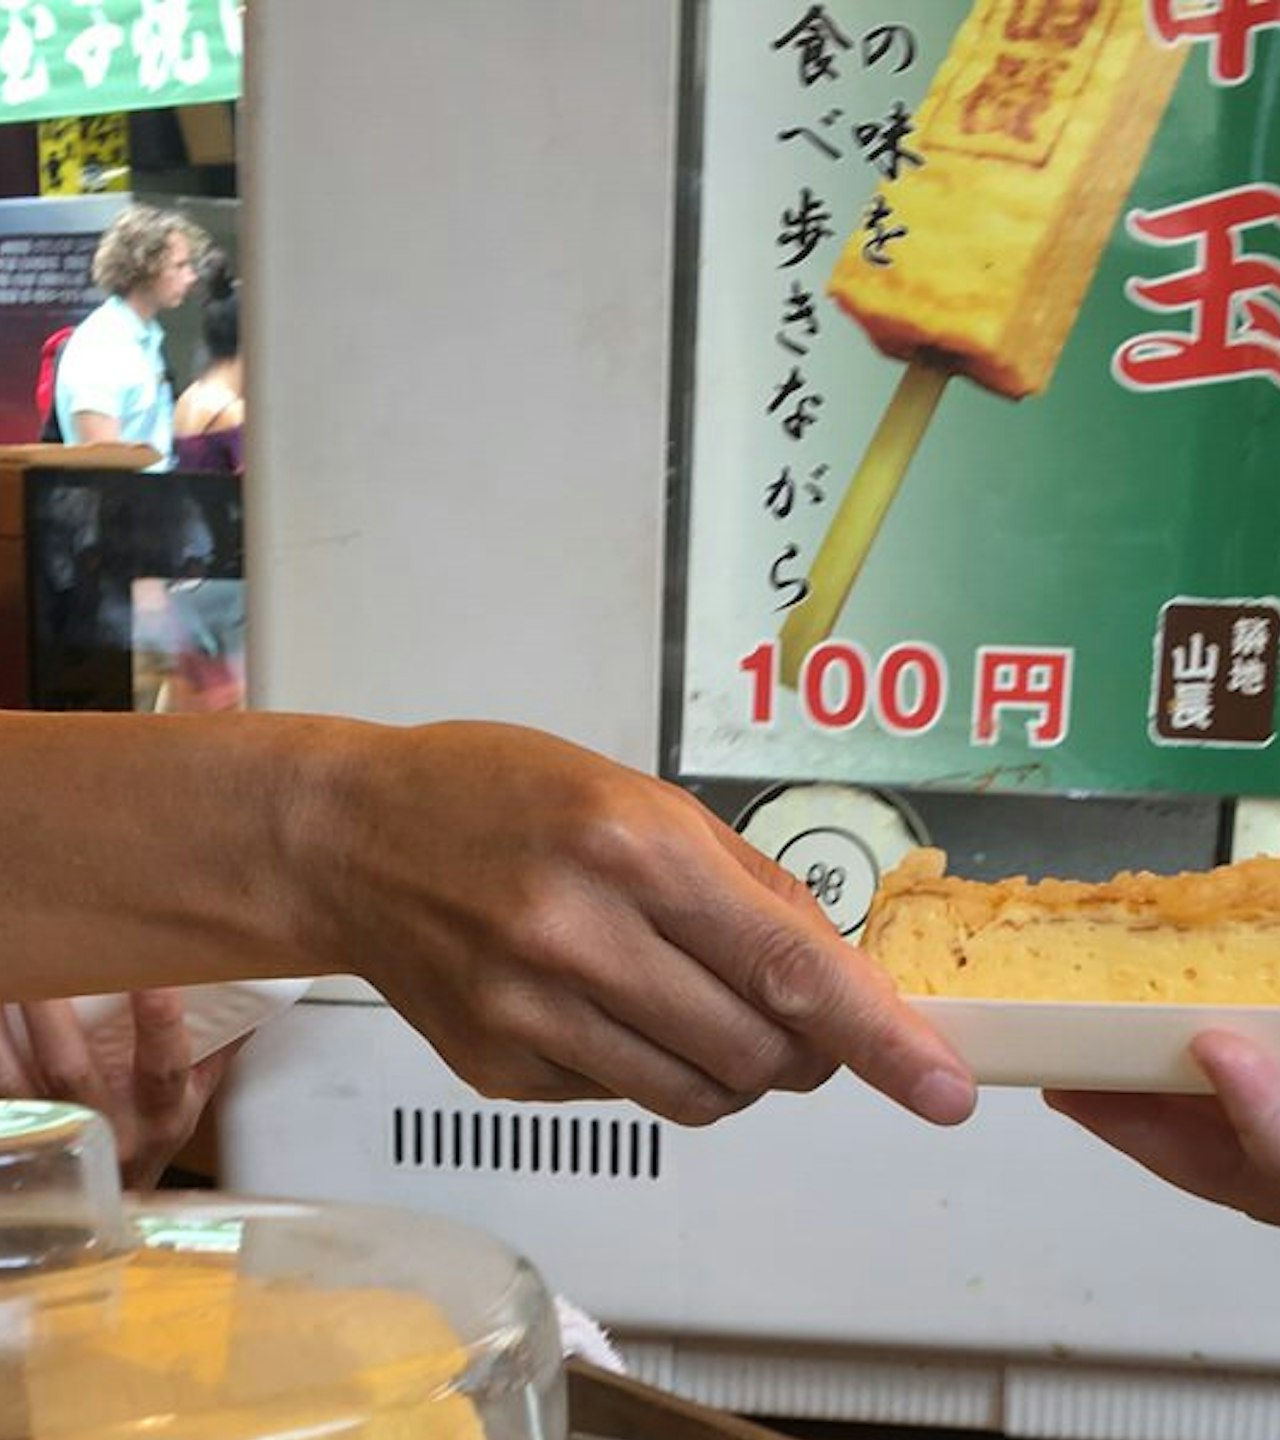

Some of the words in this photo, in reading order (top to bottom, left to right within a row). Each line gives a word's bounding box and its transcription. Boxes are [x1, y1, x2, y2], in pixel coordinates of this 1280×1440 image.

[853, 22, 925, 268] の味を
[764, 3, 854, 613] 食べ歩きながら
[1168, 631, 1221, 732] 山長
